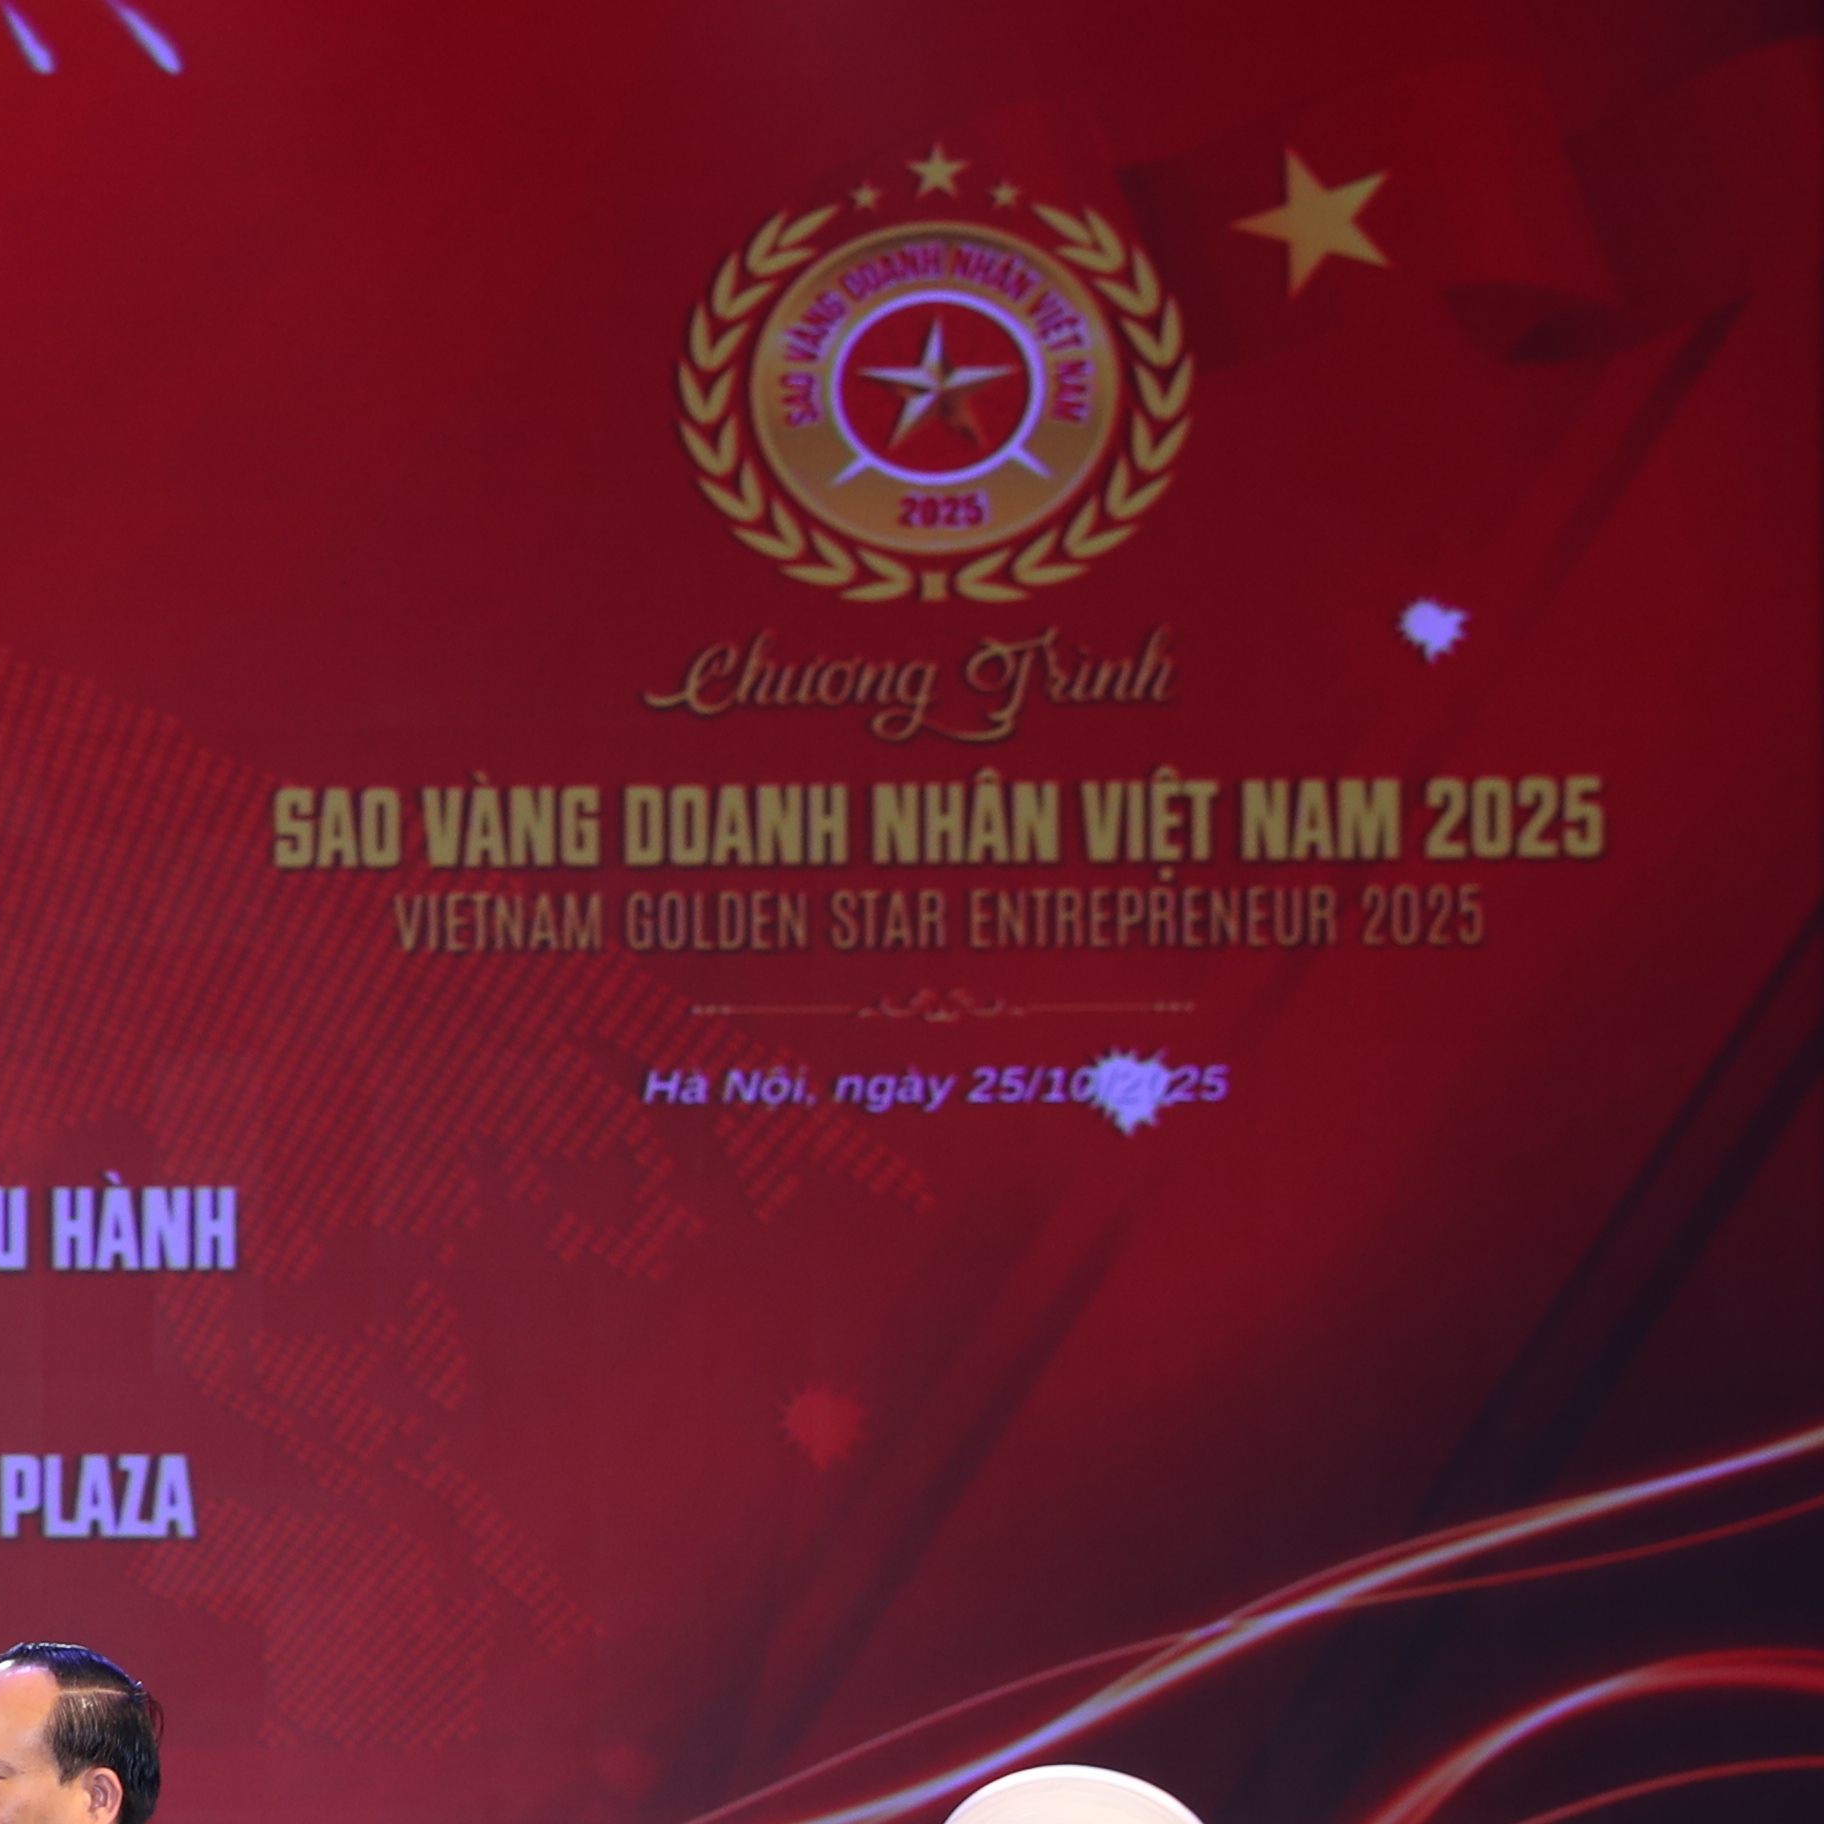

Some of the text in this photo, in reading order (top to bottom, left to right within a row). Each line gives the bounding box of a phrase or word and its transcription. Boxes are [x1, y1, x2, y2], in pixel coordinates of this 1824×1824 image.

[898, 489, 991, 529] 2025
[643, 623, 1173, 742] Chương Trình
[273, 766, 1605, 882] SAO VÀNG DOANH NHÂN VIỆT NAM 2025
[394, 884, 1484, 952] VIETNAM GOLDEN STAR ENTREPRENEUR 2025
[644, 1068, 708, 1104] Hà
[723, 1068, 815, 1110] Nội,
[834, 1066, 957, 1113] ngày
[52, 1171, 237, 1270] HÀNH
